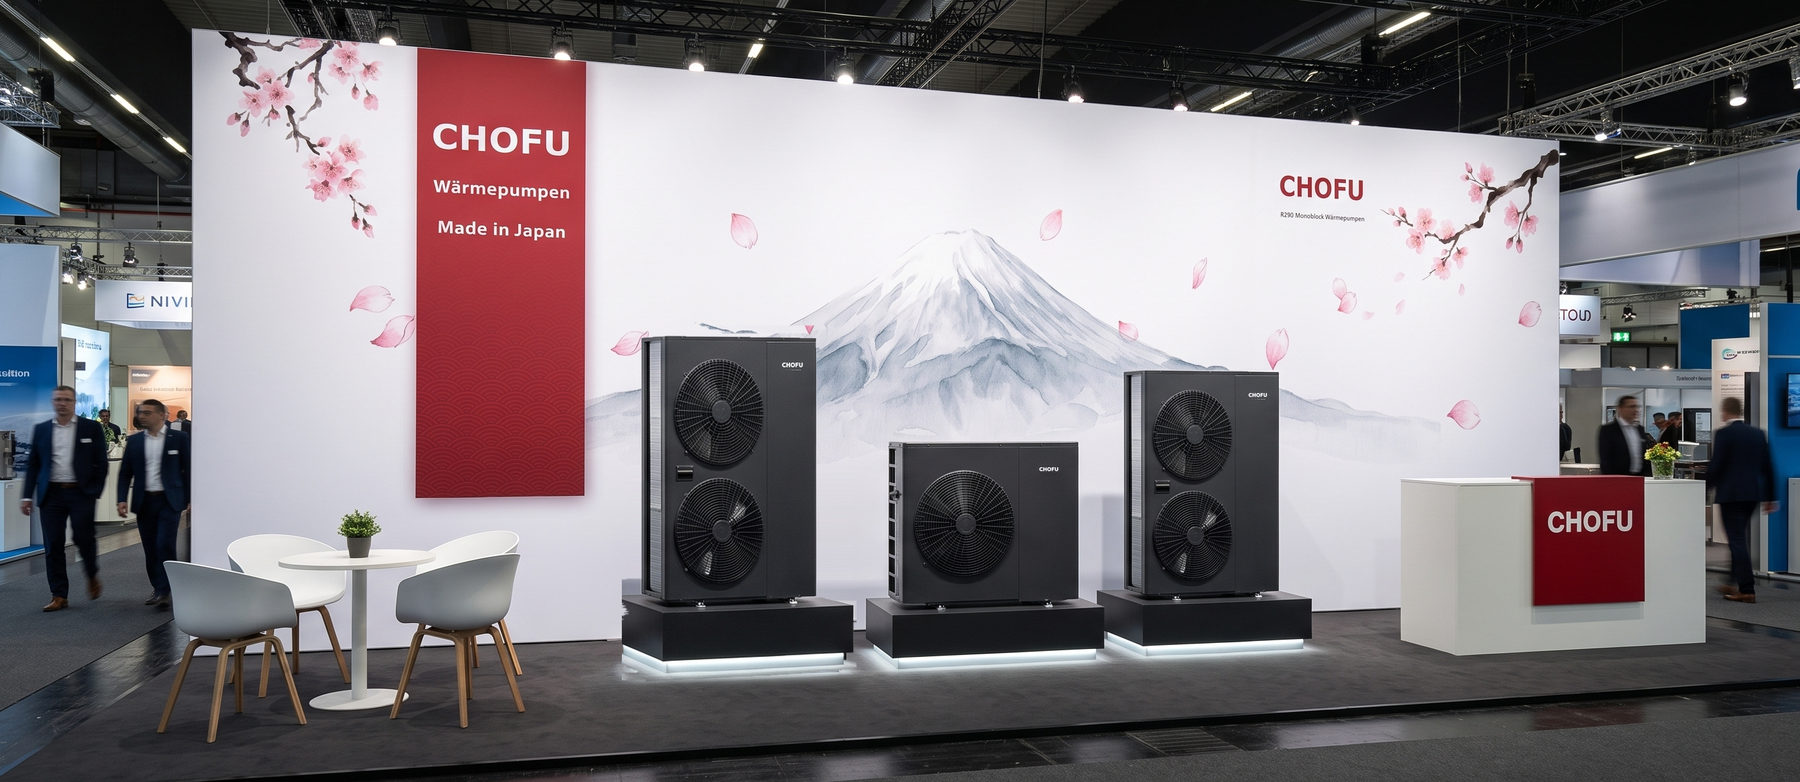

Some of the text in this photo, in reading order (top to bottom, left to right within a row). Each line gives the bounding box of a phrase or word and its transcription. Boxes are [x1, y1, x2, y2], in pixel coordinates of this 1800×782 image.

[432, 123, 570, 156] CHOFU
[433, 179, 570, 201] Wärmepumpen
[1280, 175, 1364, 201] CHOFU
[1295, 212, 1324, 220] Monoblock
[1325, 213, 1366, 222] Wärmepumpen
[437, 220, 566, 241] Made in Japan
[1547, 510, 1633, 533] CHOFU
